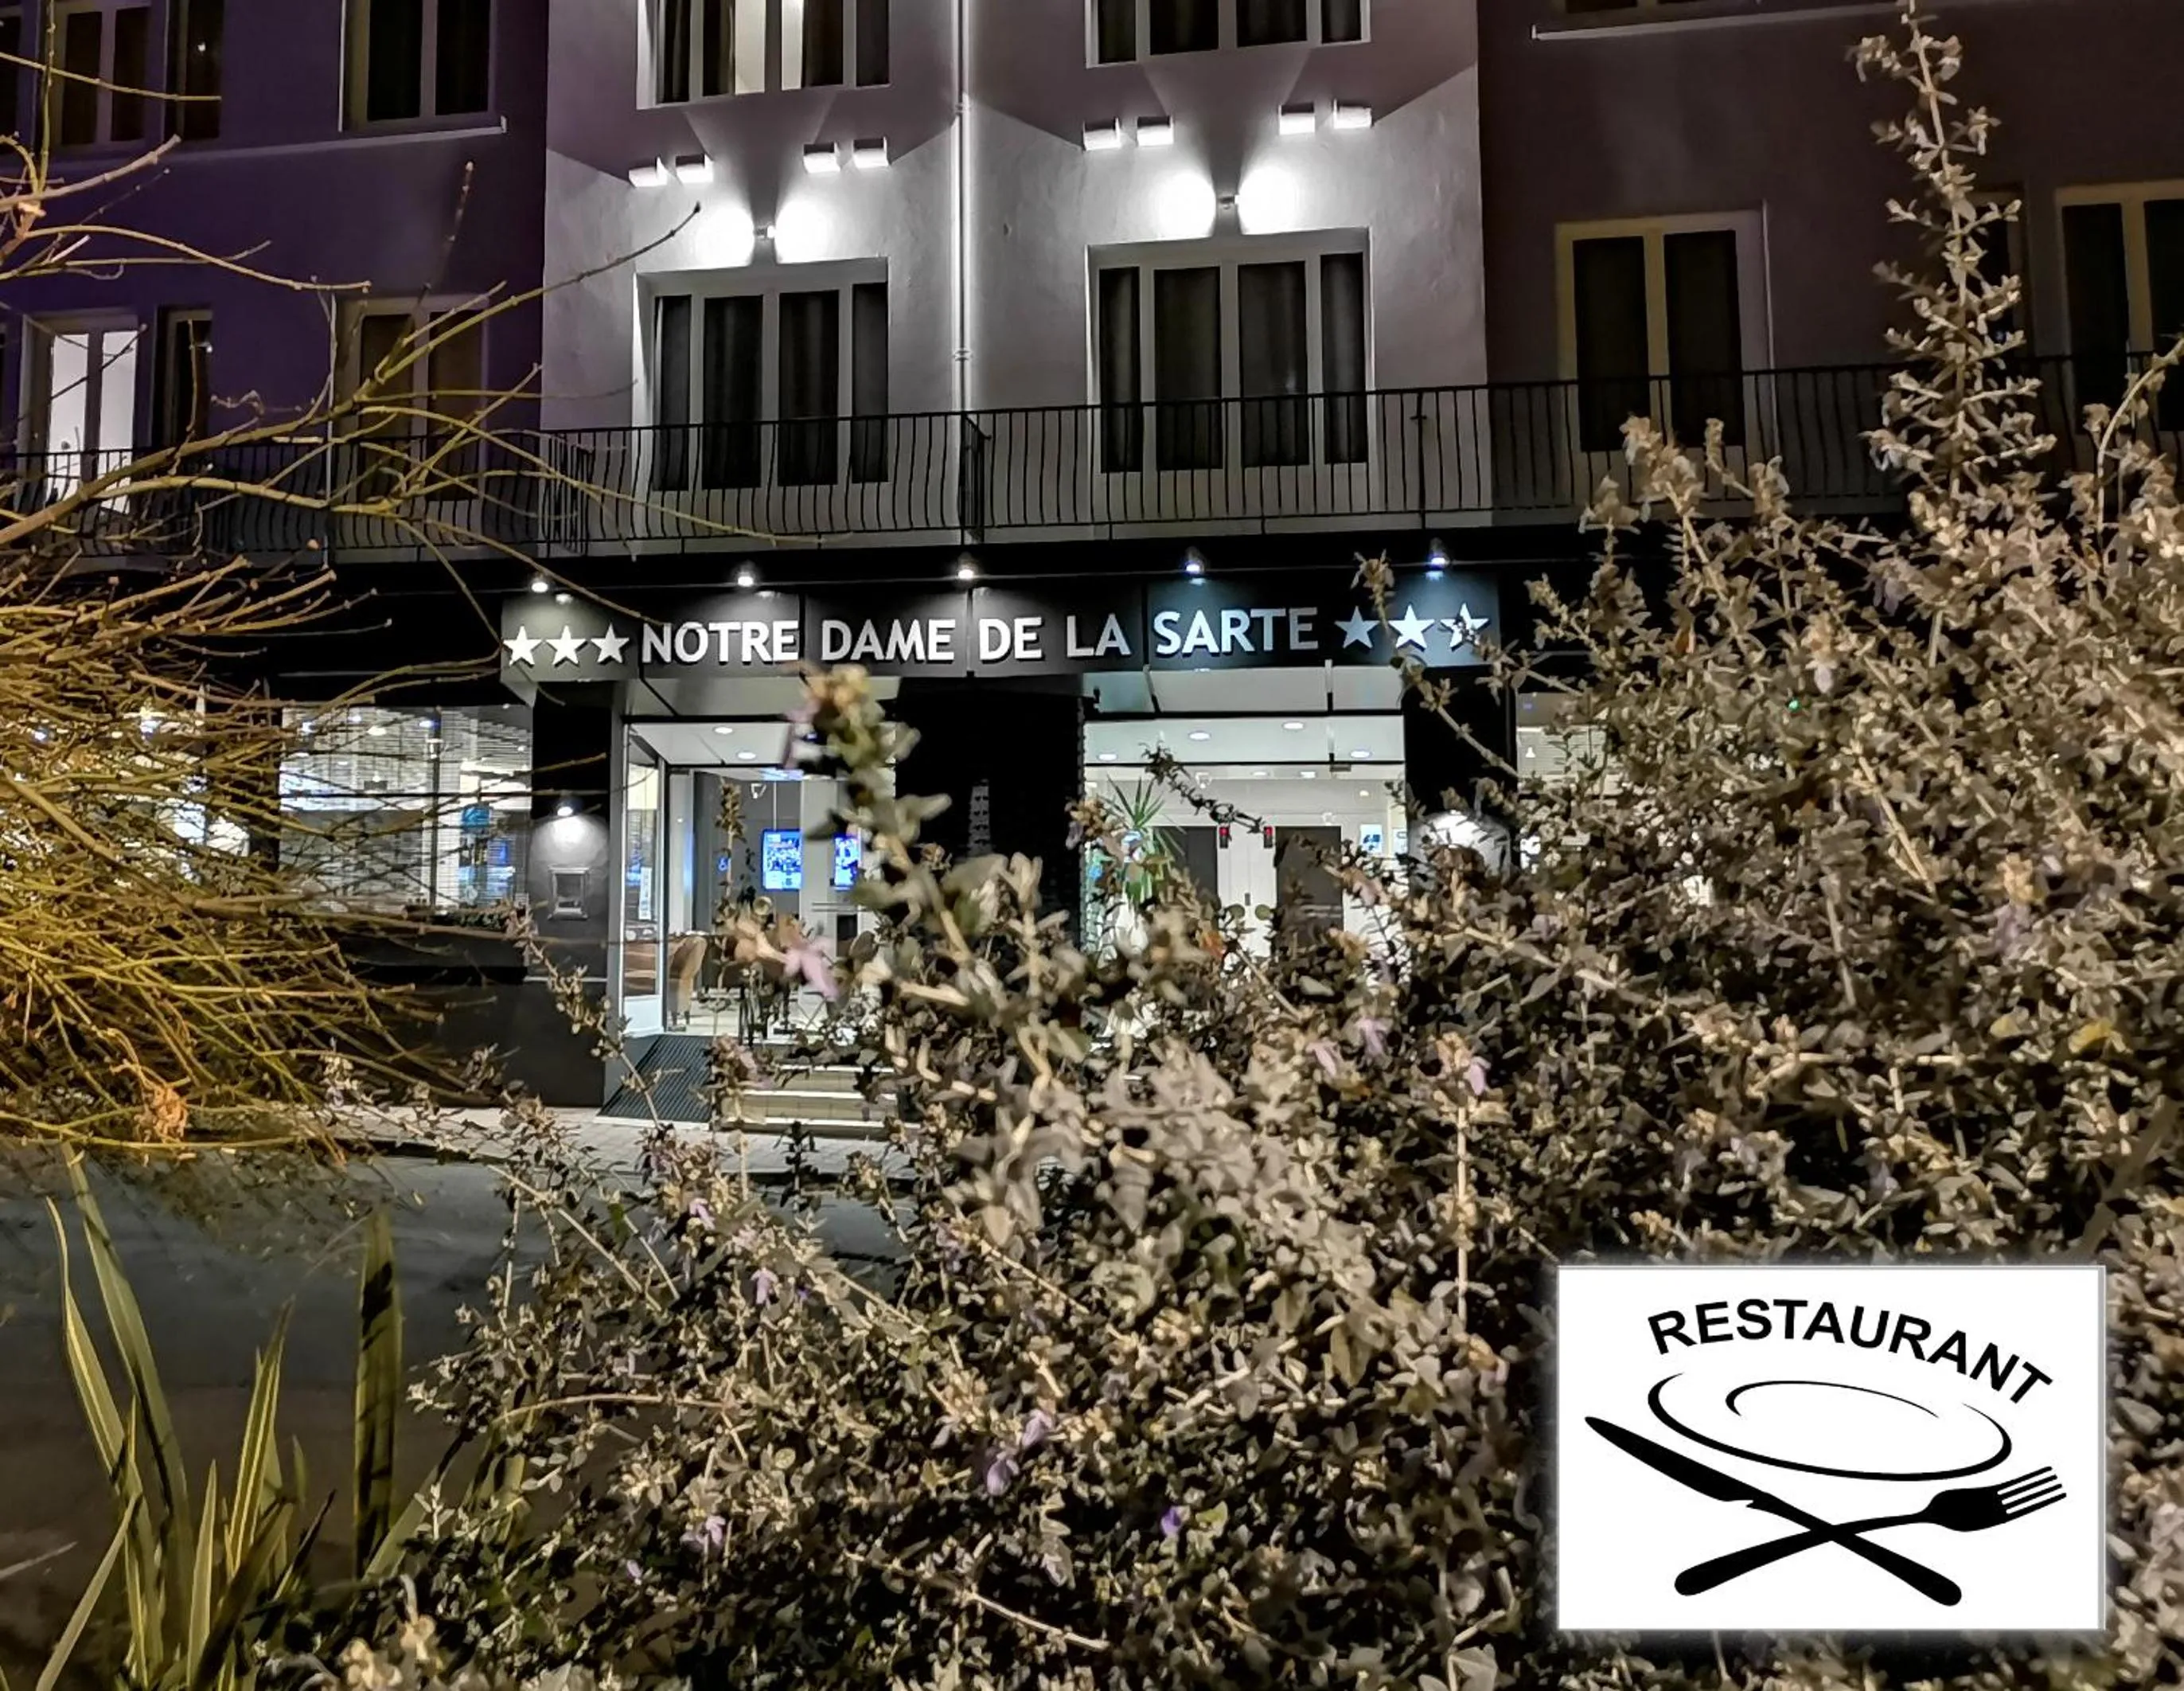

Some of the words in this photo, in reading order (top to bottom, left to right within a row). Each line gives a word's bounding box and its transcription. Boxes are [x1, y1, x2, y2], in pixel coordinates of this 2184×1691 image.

[642, 619, 799, 663] NOTRE
[821, 619, 955, 661] DAME
[979, 617, 1043, 661] DE
[1066, 614, 1131, 658] LA
[1153, 607, 1319, 655] SARTE
